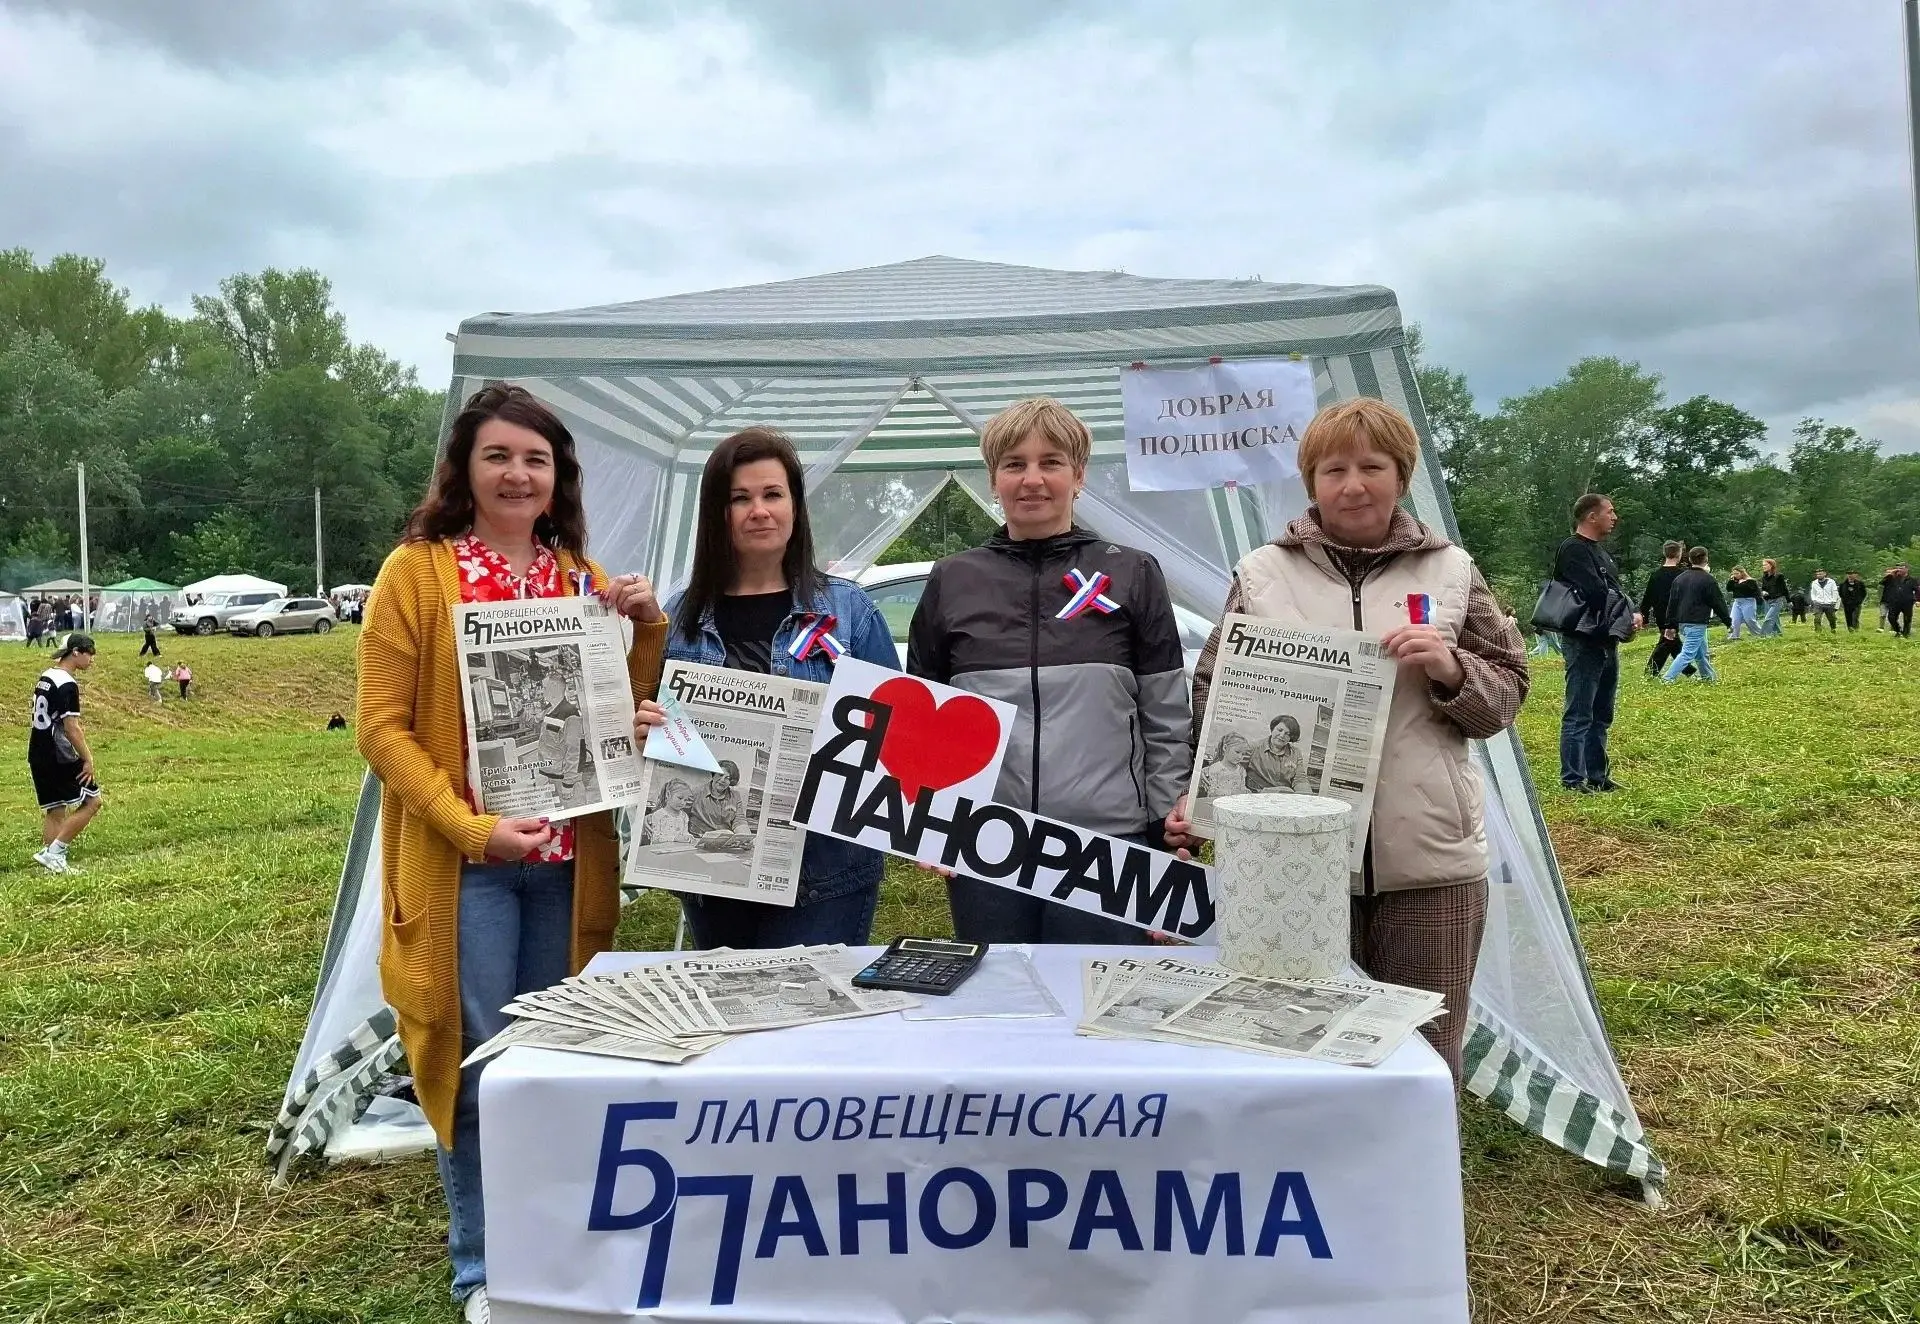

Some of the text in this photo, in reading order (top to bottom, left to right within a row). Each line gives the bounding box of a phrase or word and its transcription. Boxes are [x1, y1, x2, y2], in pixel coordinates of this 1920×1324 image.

[1157, 388, 1275, 422] ДОБРАЯ
[1138, 423, 1301, 458] ПОДПИСКА
[475, 616, 583, 645] ПАНОРАМА
[1233, 635, 1351, 667] ПАНОРАМА
[676, 682, 786, 712] ПАНОРАМА
[1221, 680, 1328, 703] инновации, традиции
[32, 693, 51, 730] 8
[691, 717, 728, 731] ёрство,
[720, 735, 765, 748] традиции
[815, 695, 893, 772] Я
[483, 760, 553, 776] Три слагаемых
[483, 778, 516, 790] успеха
[793, 754, 1216, 939] ПАНОРАМУ
[587, 1092, 1169, 1232] БЛАГОВЕЩЕНСКАЯ
[636, 1167, 1334, 1310] ПАНОРАМА
